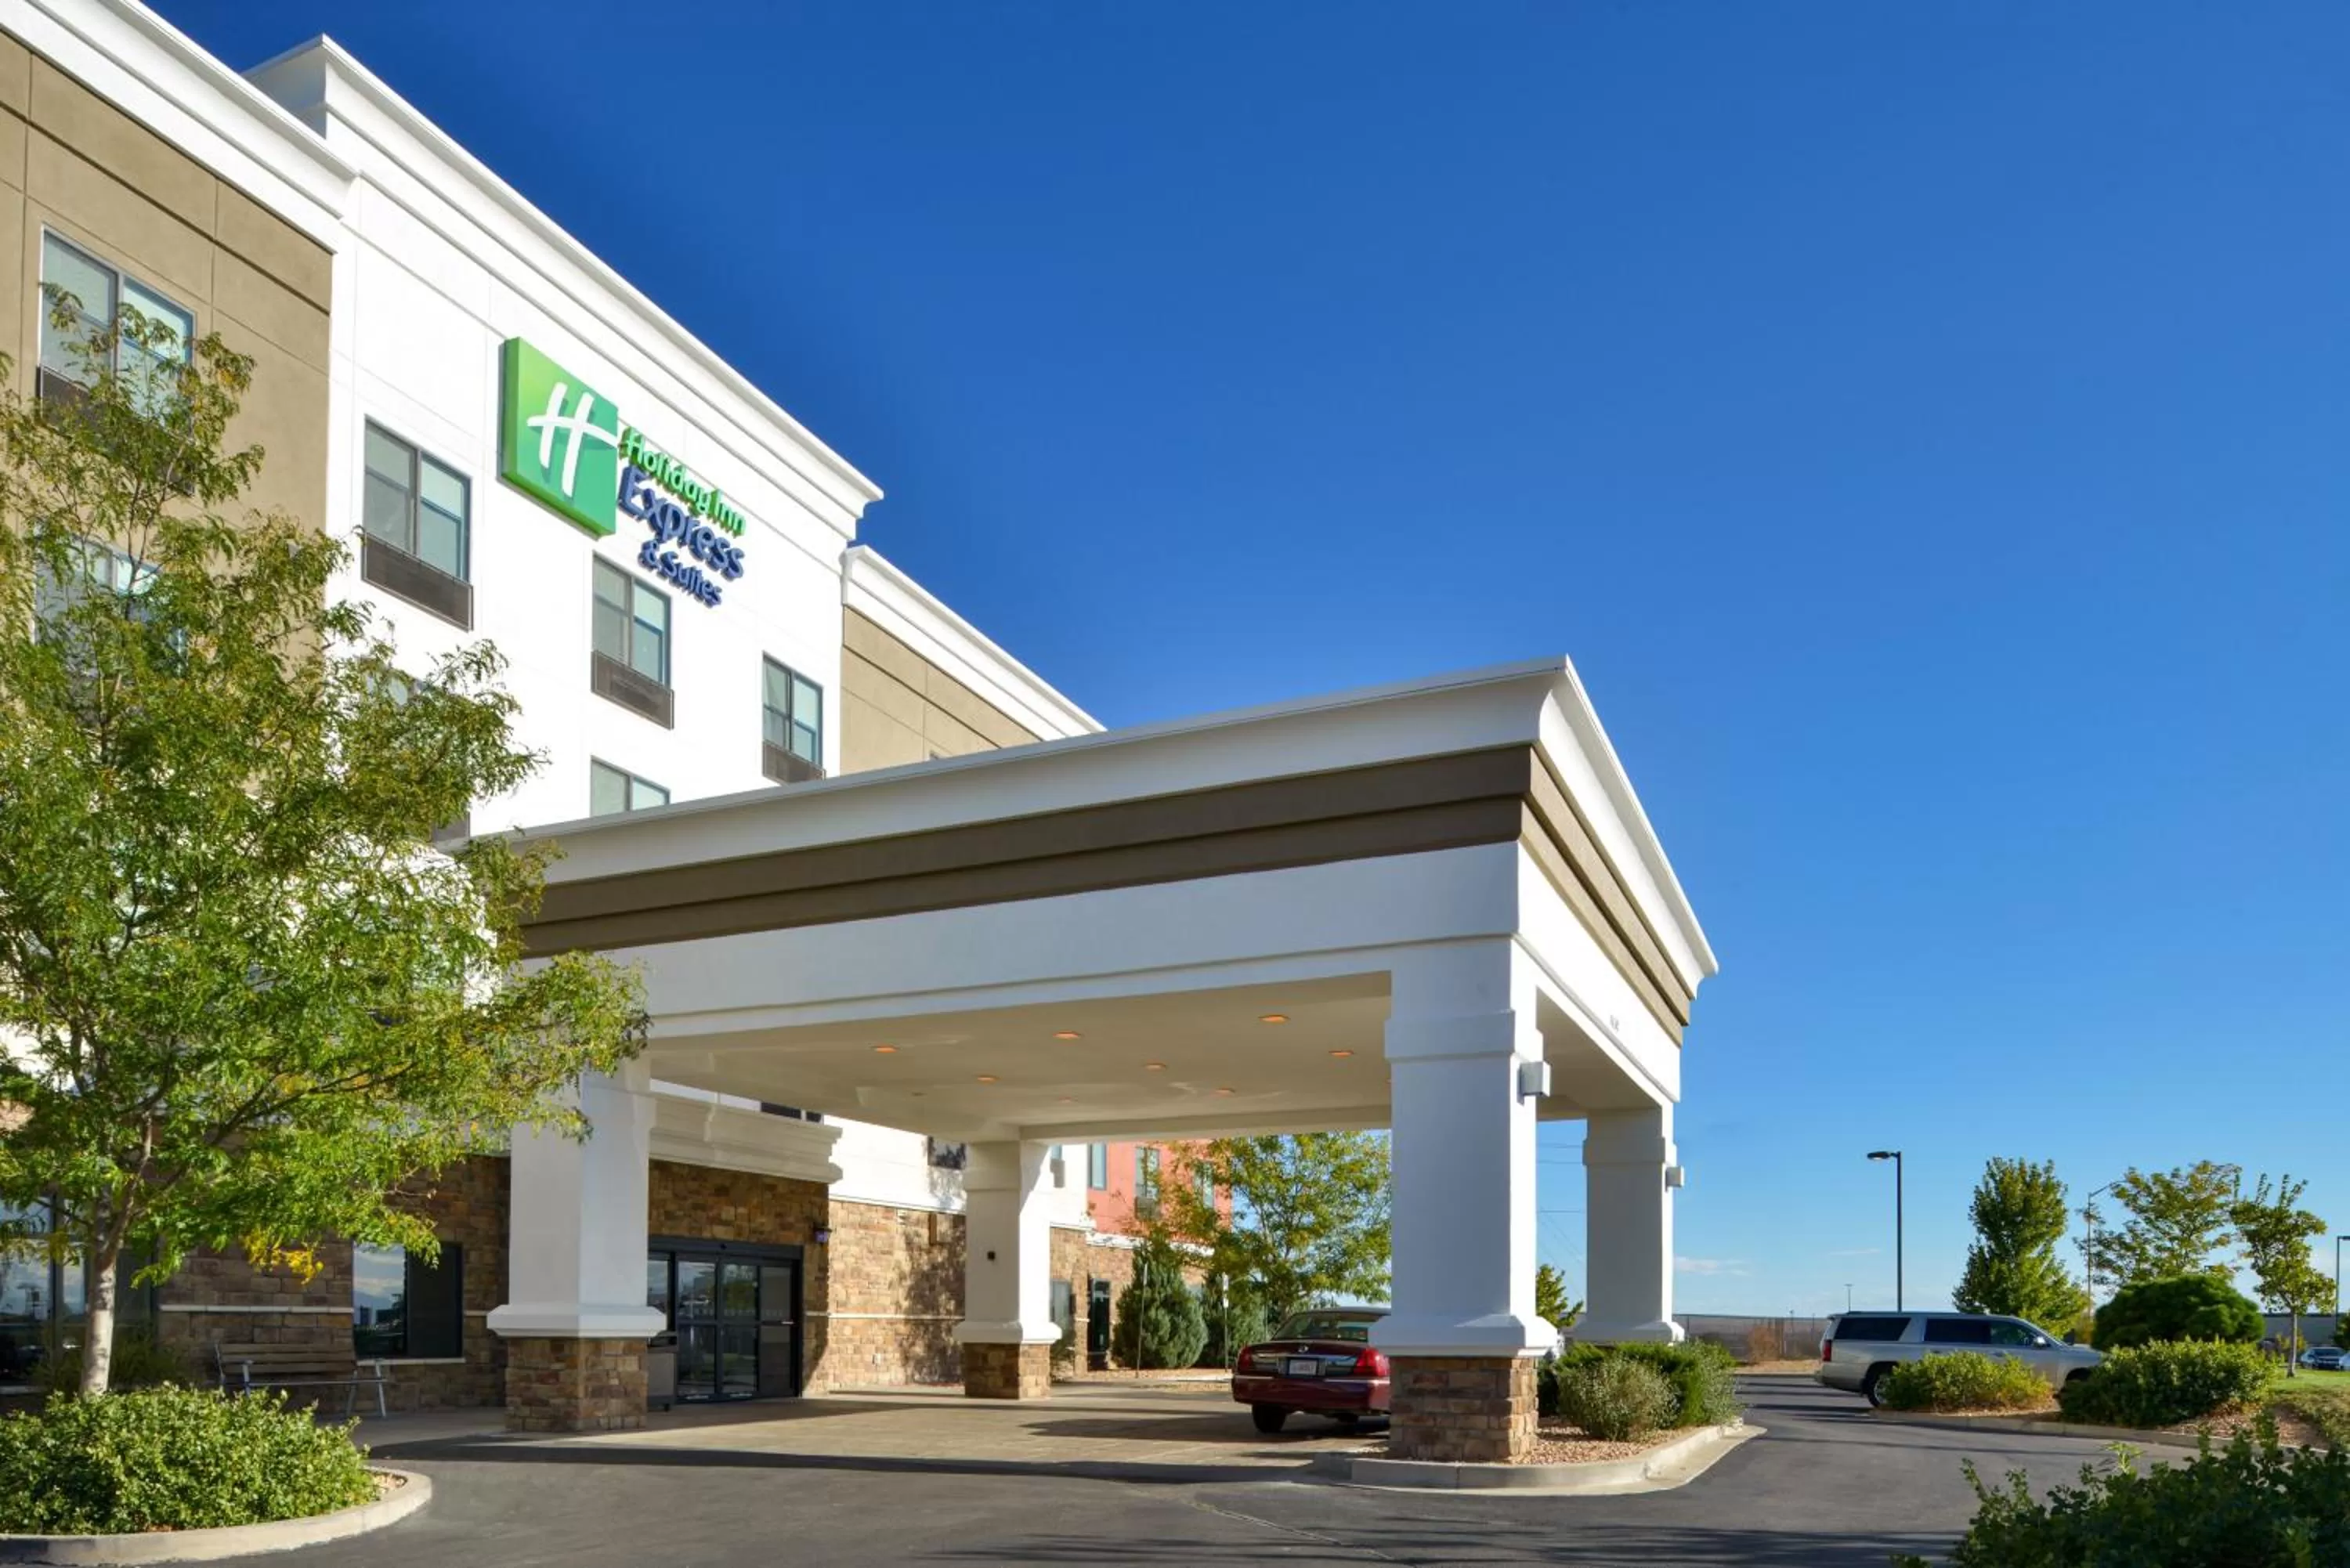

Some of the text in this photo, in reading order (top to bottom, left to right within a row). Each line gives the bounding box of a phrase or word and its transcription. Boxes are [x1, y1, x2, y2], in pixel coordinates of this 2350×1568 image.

[526, 381, 617, 497] H
[618, 425, 747, 539] Holiday Inn
[617, 464, 746, 582] Express
[638, 540, 722, 608] & Suites
